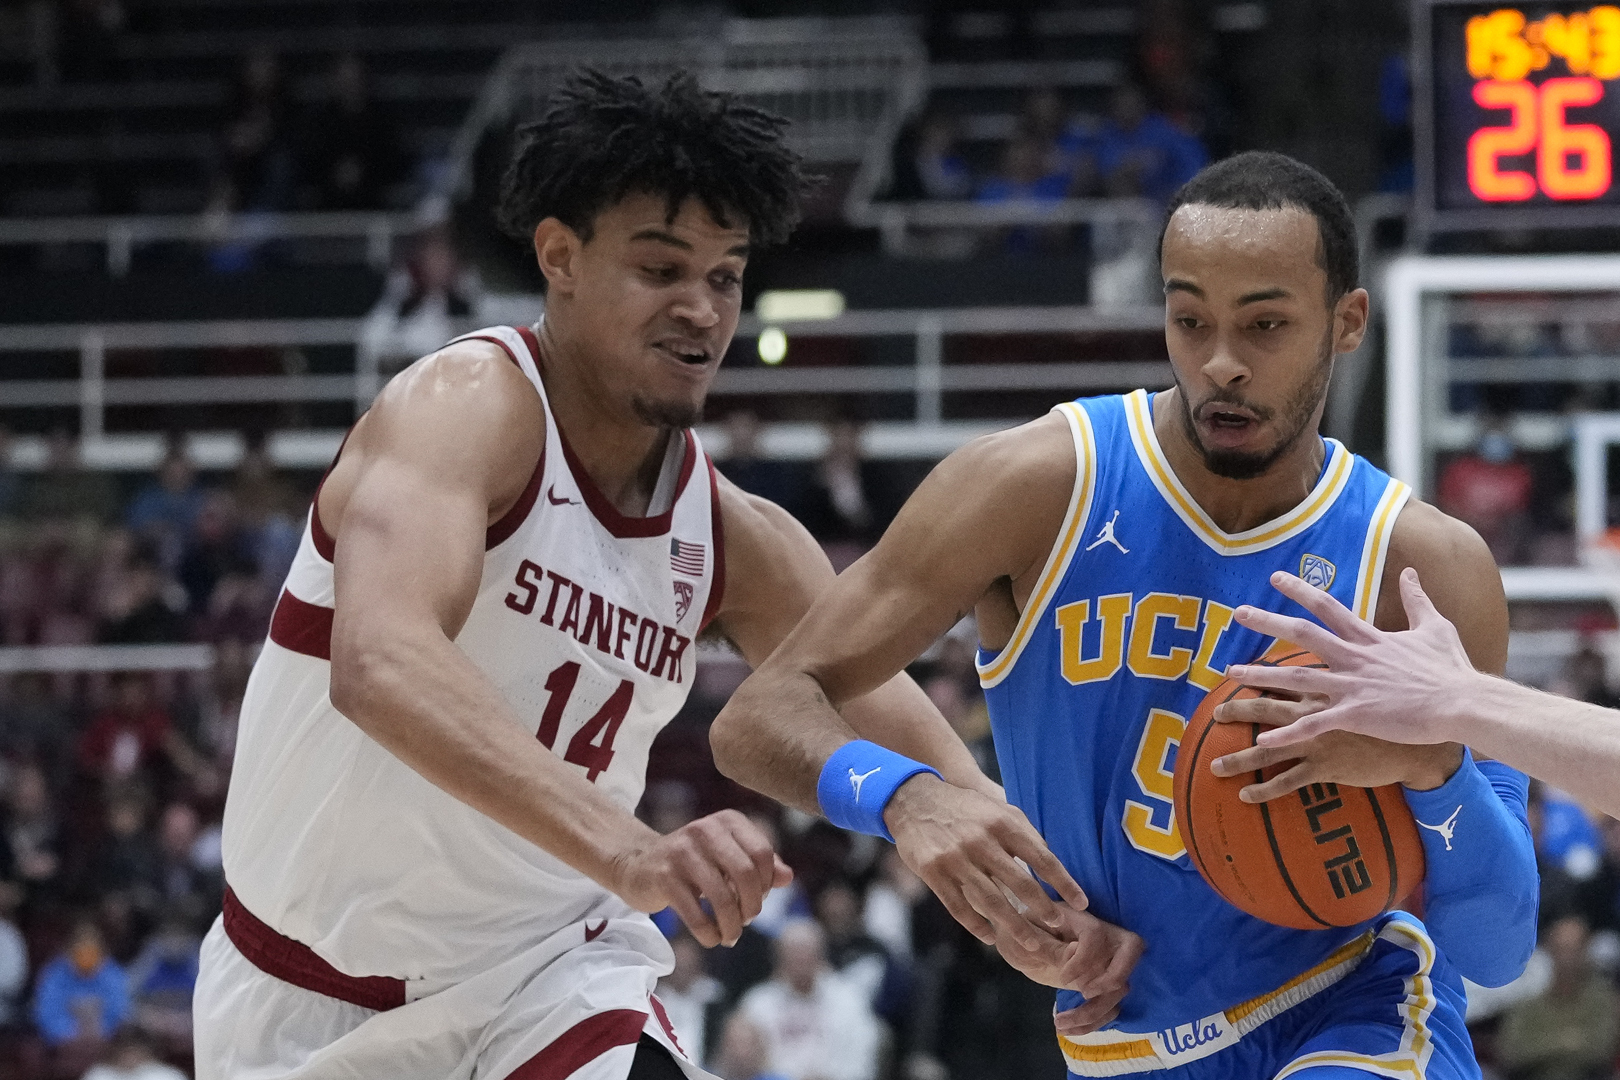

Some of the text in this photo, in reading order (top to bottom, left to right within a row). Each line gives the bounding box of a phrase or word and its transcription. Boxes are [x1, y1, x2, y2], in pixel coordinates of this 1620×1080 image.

[1466, 76, 1612, 203] 26
[504, 558, 691, 684] STANFOR
[1056, 591, 1300, 692] UCL
[536, 660, 635, 784] 14
